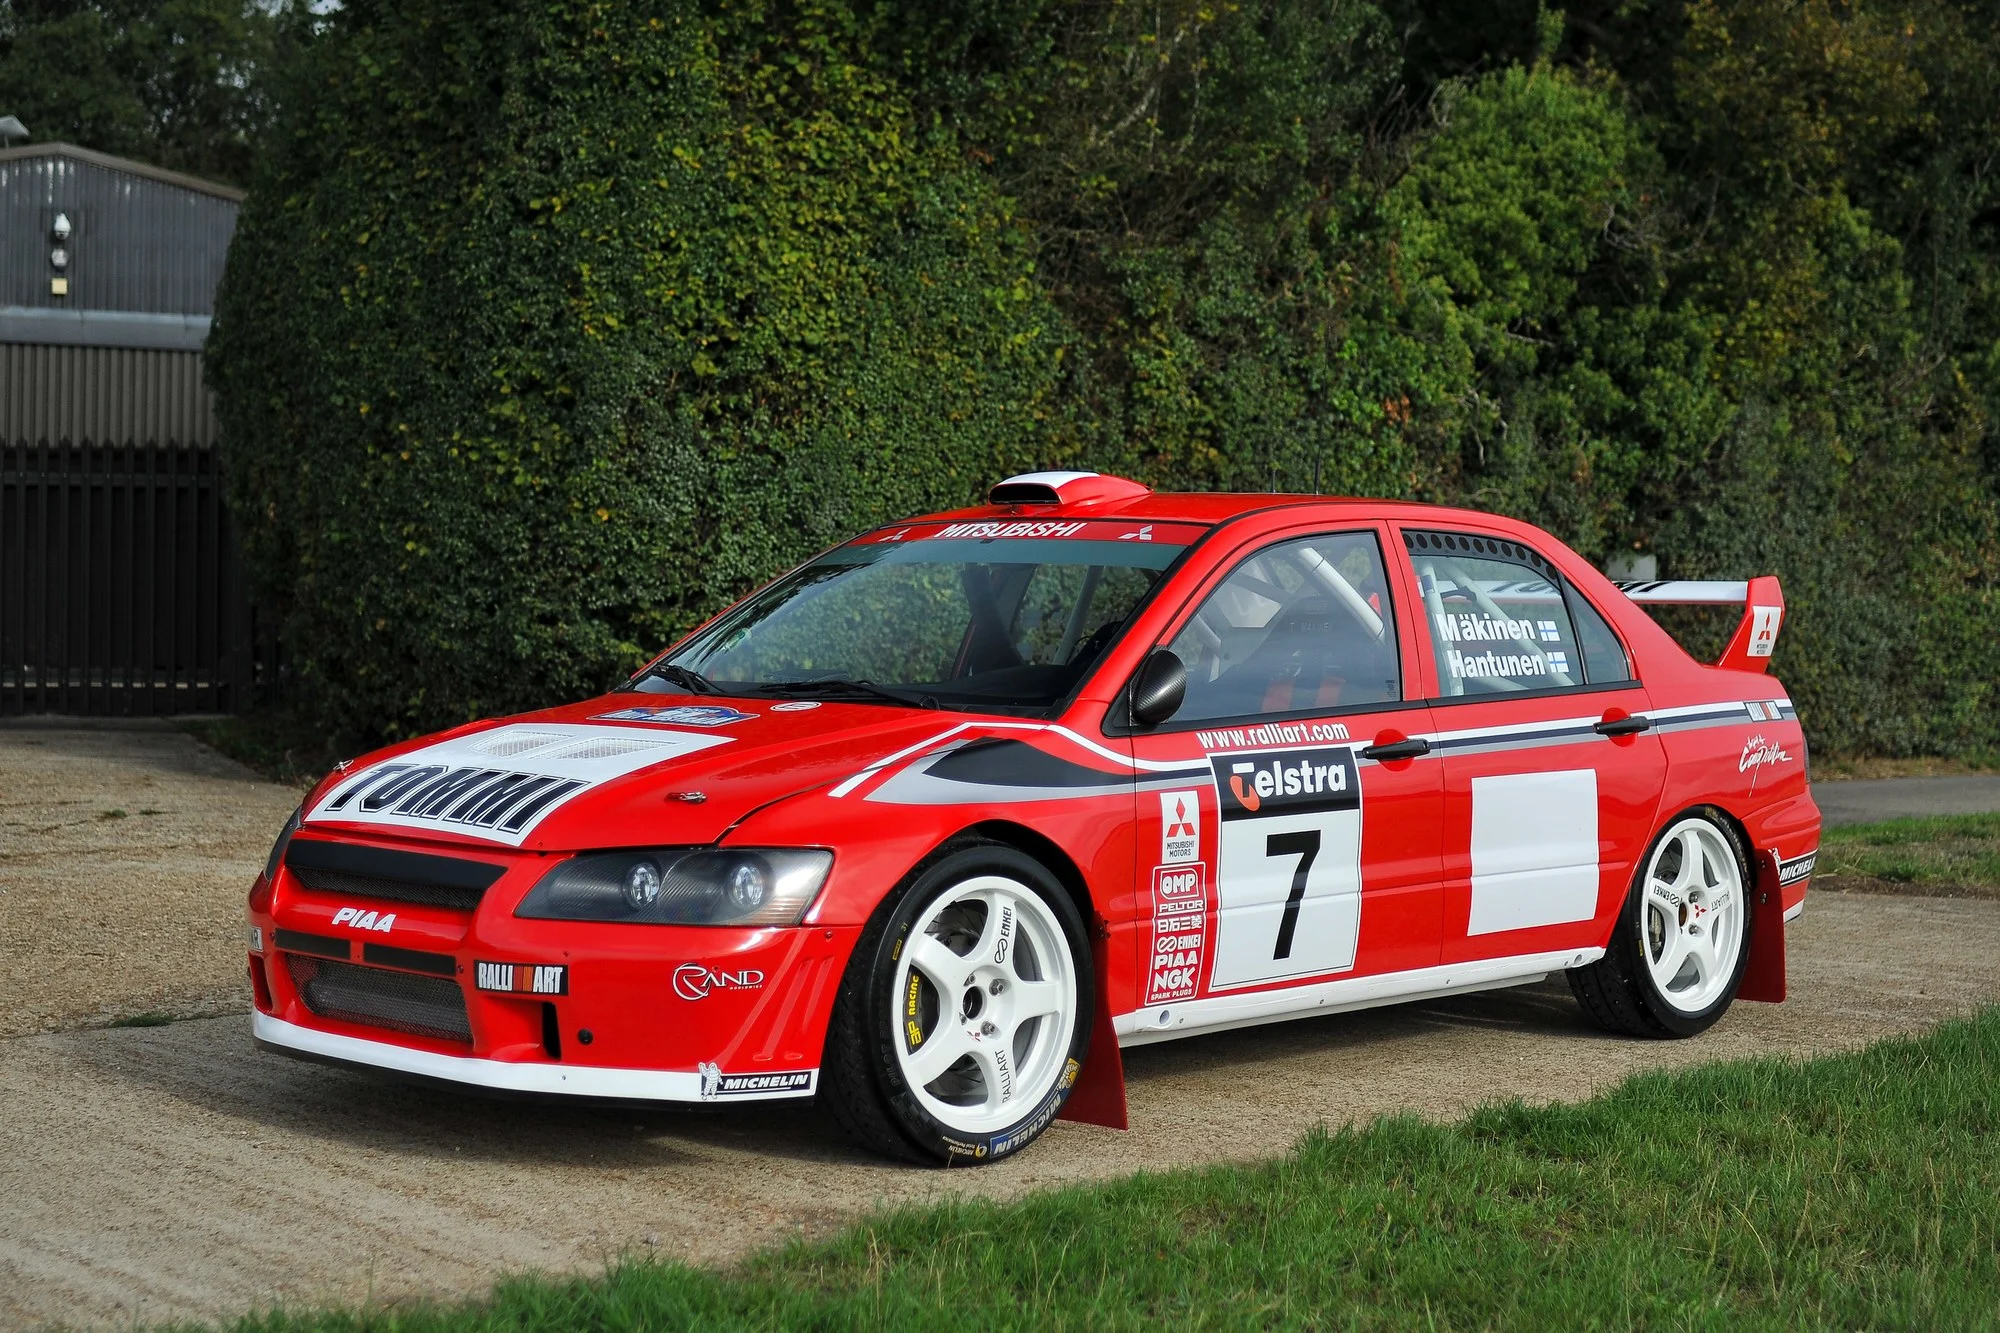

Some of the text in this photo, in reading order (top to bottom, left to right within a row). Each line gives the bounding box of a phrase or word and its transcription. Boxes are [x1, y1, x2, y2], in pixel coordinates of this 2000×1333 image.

[934, 522, 1087, 537] MITSUBISHI
[1435, 613, 1536, 641] Mäkinen
[1447, 650, 1546, 678] Hantunen
[1196, 723, 1350, 749] www.ralliart.com
[1230, 760, 1346, 803] Telstra
[325, 764, 591, 835] TOMMI
[1167, 840, 1195, 850] MITSUBISHI
[1169, 849, 1192, 858] MOTORS
[1779, 856, 1816, 881] MICHELI
[1162, 874, 1196, 895] OMP
[1266, 829, 1321, 960] 7
[1159, 900, 1204, 913] PELTOR
[332, 907, 397, 933] PIAA
[1157, 915, 1203, 933] 日石三菱
[1177, 934, 1202, 950] ENKEI
[1154, 950, 1198, 970] PIAA
[673, 963, 764, 1001] RAND
[1153, 966, 1196, 993] NGK
[1151, 989, 1192, 1001] SPARK PLUGS
[723, 1073, 809, 1089] MICHELIN
[995, 1049, 1012, 1104] RALLIART
[993, 1094, 1062, 1155] MICHELIN
